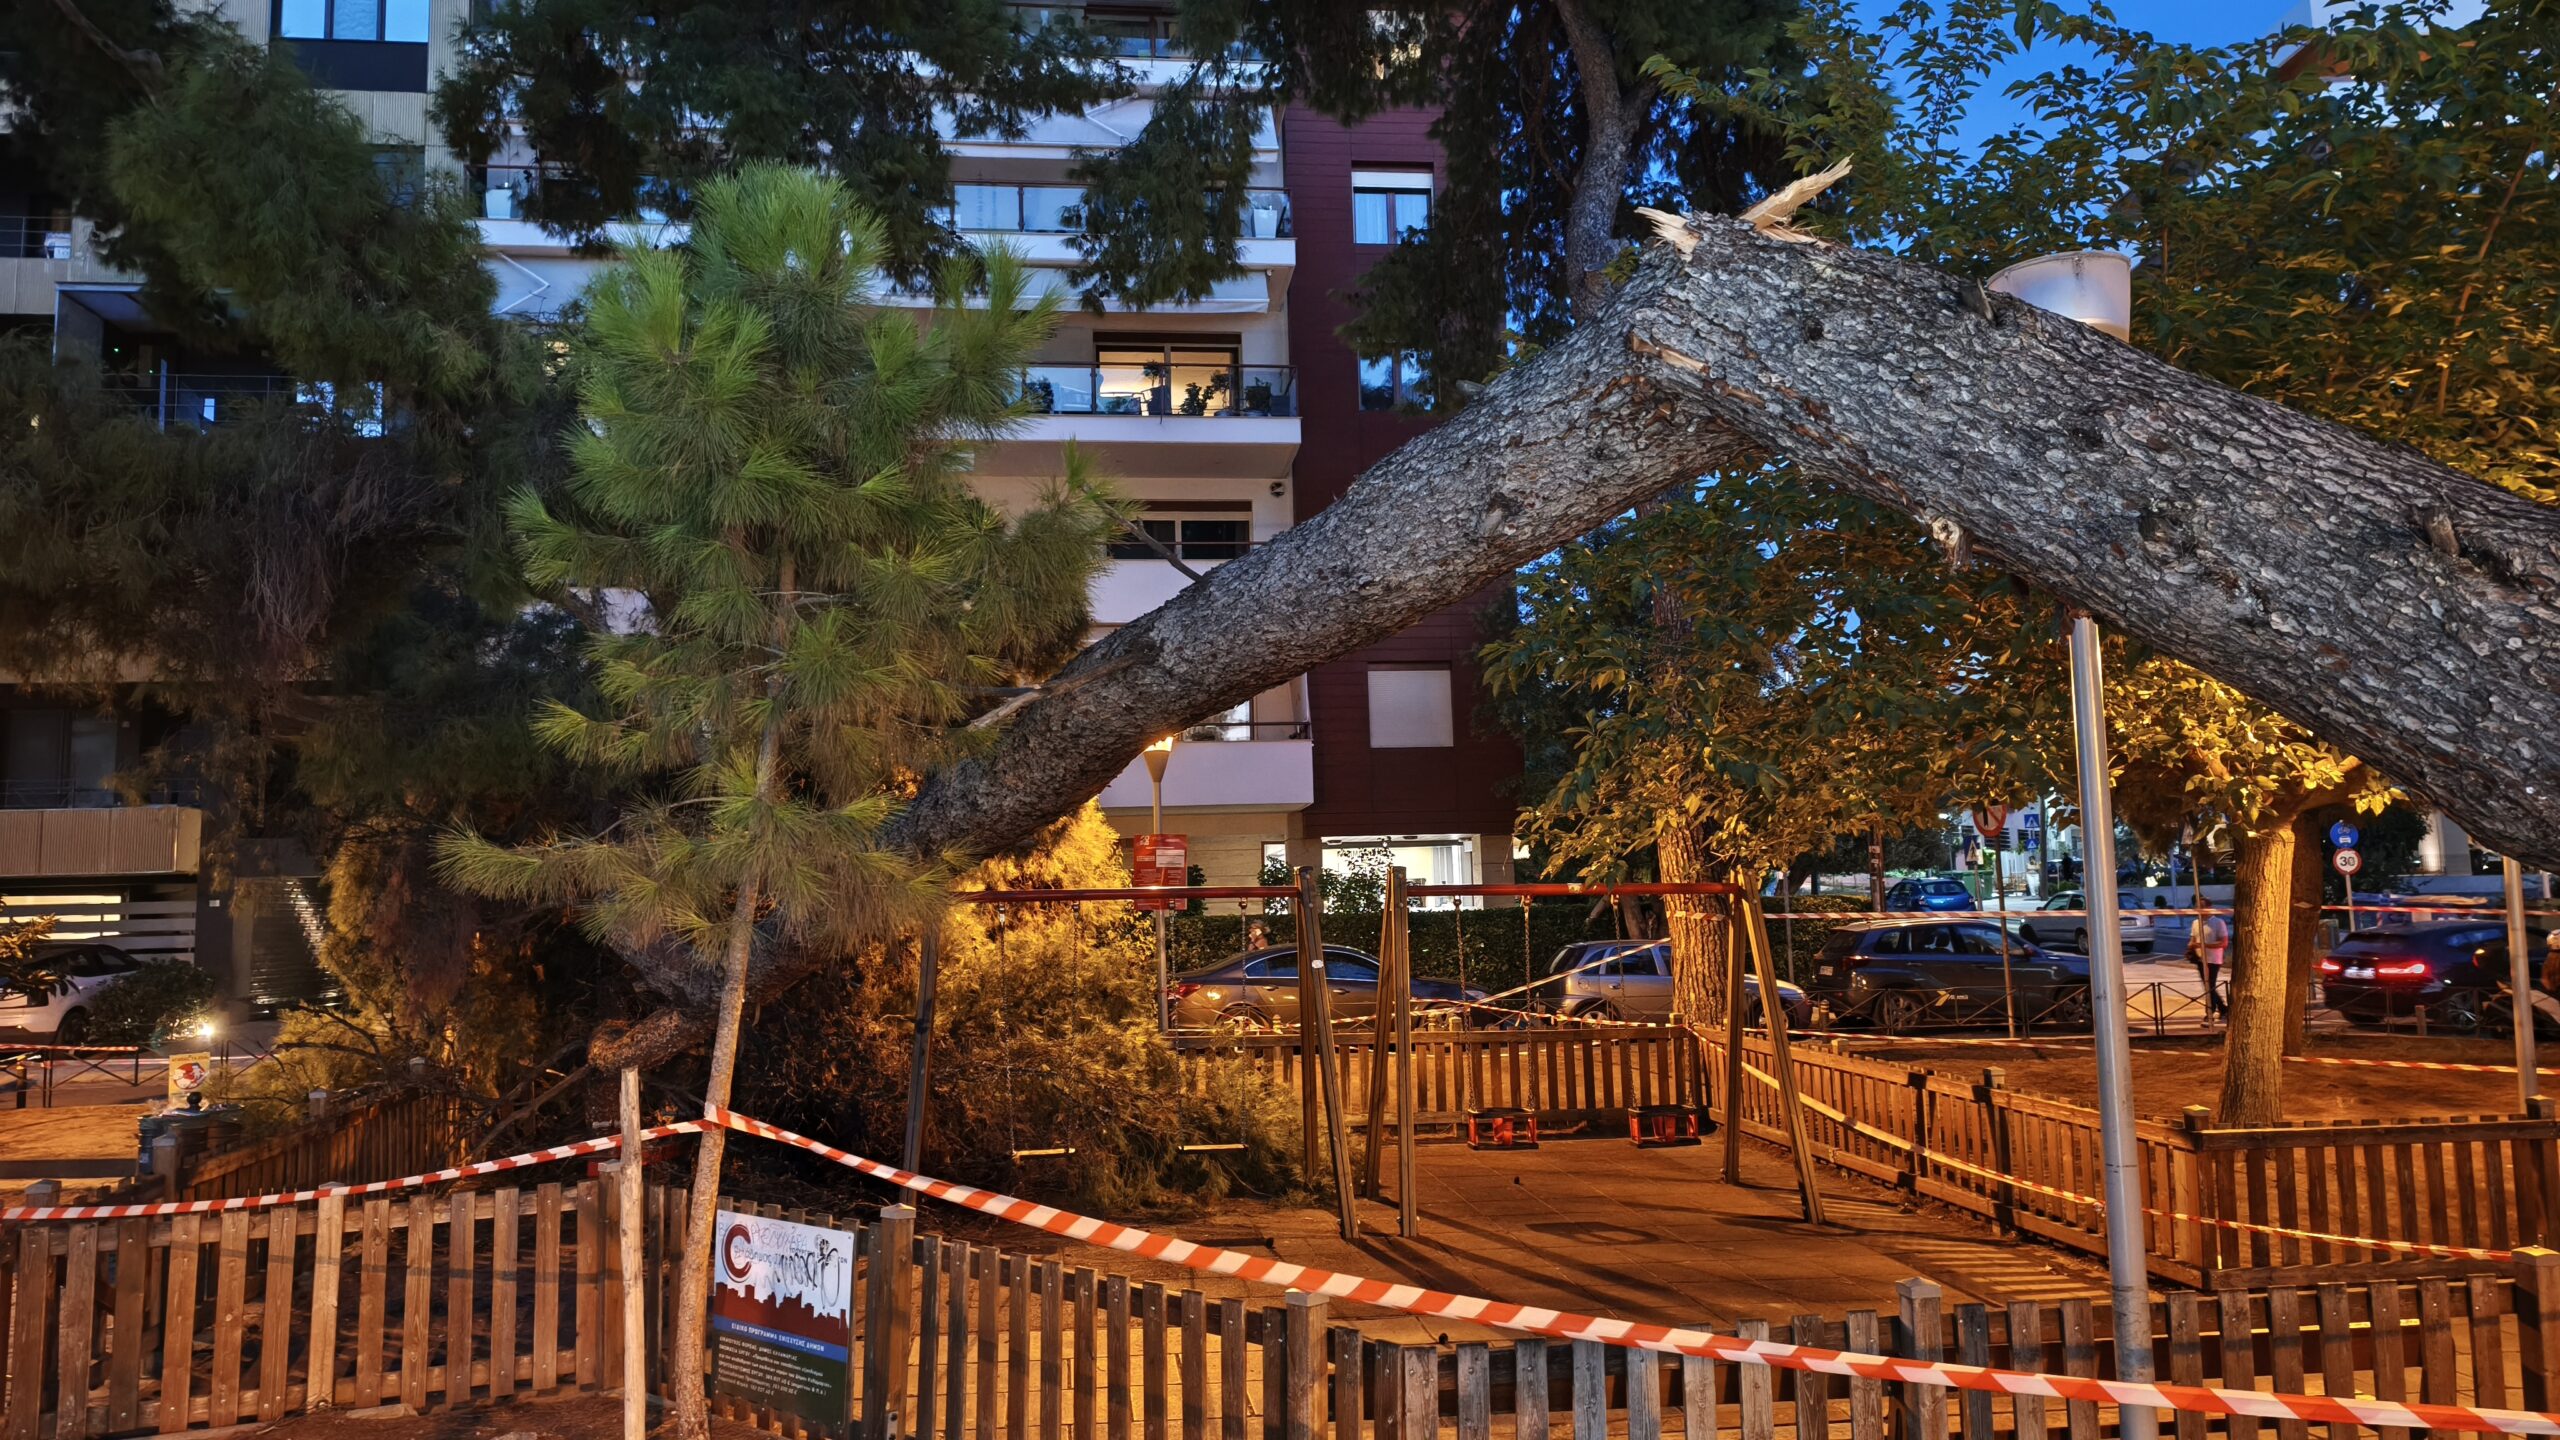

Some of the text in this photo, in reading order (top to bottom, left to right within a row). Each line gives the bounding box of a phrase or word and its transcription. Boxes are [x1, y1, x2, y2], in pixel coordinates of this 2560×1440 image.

[2340, 856, 2356, 867] 30
[731, 1322, 825, 1352] ΕΙΔΙΚΟ ΠΡΟΓΡΑΜΜΑ ΕΝΙΣΧΥΣΗΣ ΔΗΜΩΝ
